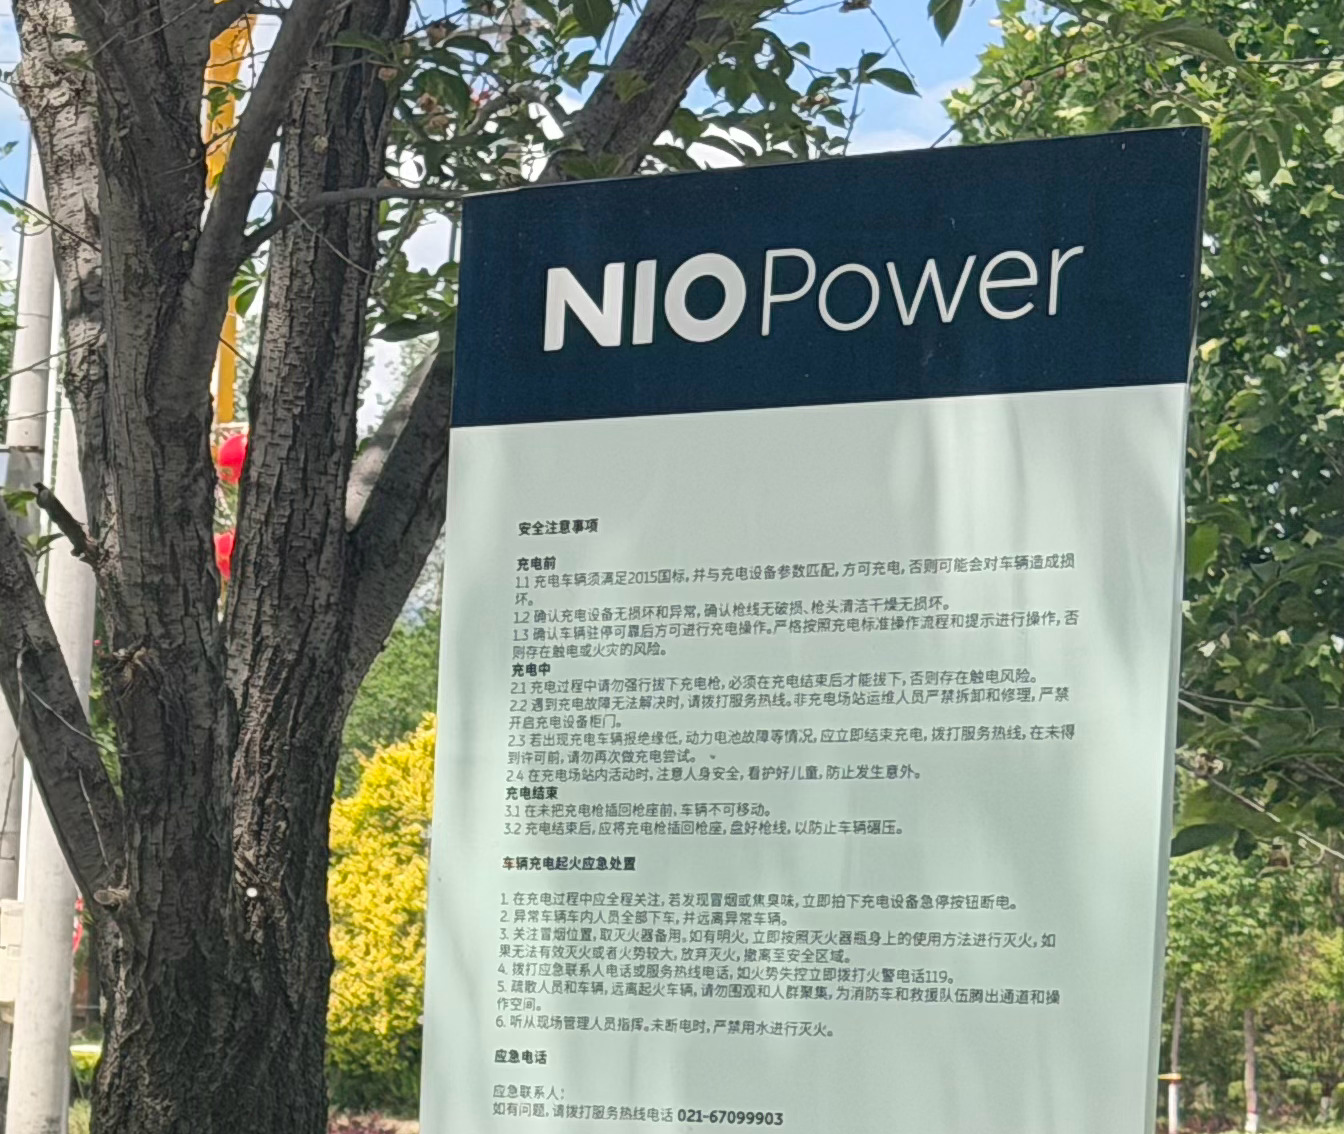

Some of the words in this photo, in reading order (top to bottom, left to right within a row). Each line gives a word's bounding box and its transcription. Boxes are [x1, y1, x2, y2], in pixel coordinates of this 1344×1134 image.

[518, 518, 599, 536] 安全注意事项
[517, 556, 556, 571] 充电前
[511, 662, 551, 677] 充电中
[505, 786, 558, 801] 充电结束
[502, 856, 636, 871] 车辆充电起火应急处置
[494, 1049, 548, 1065] 应急电话
[677, 1108, 784, 1126] 021-67099903
